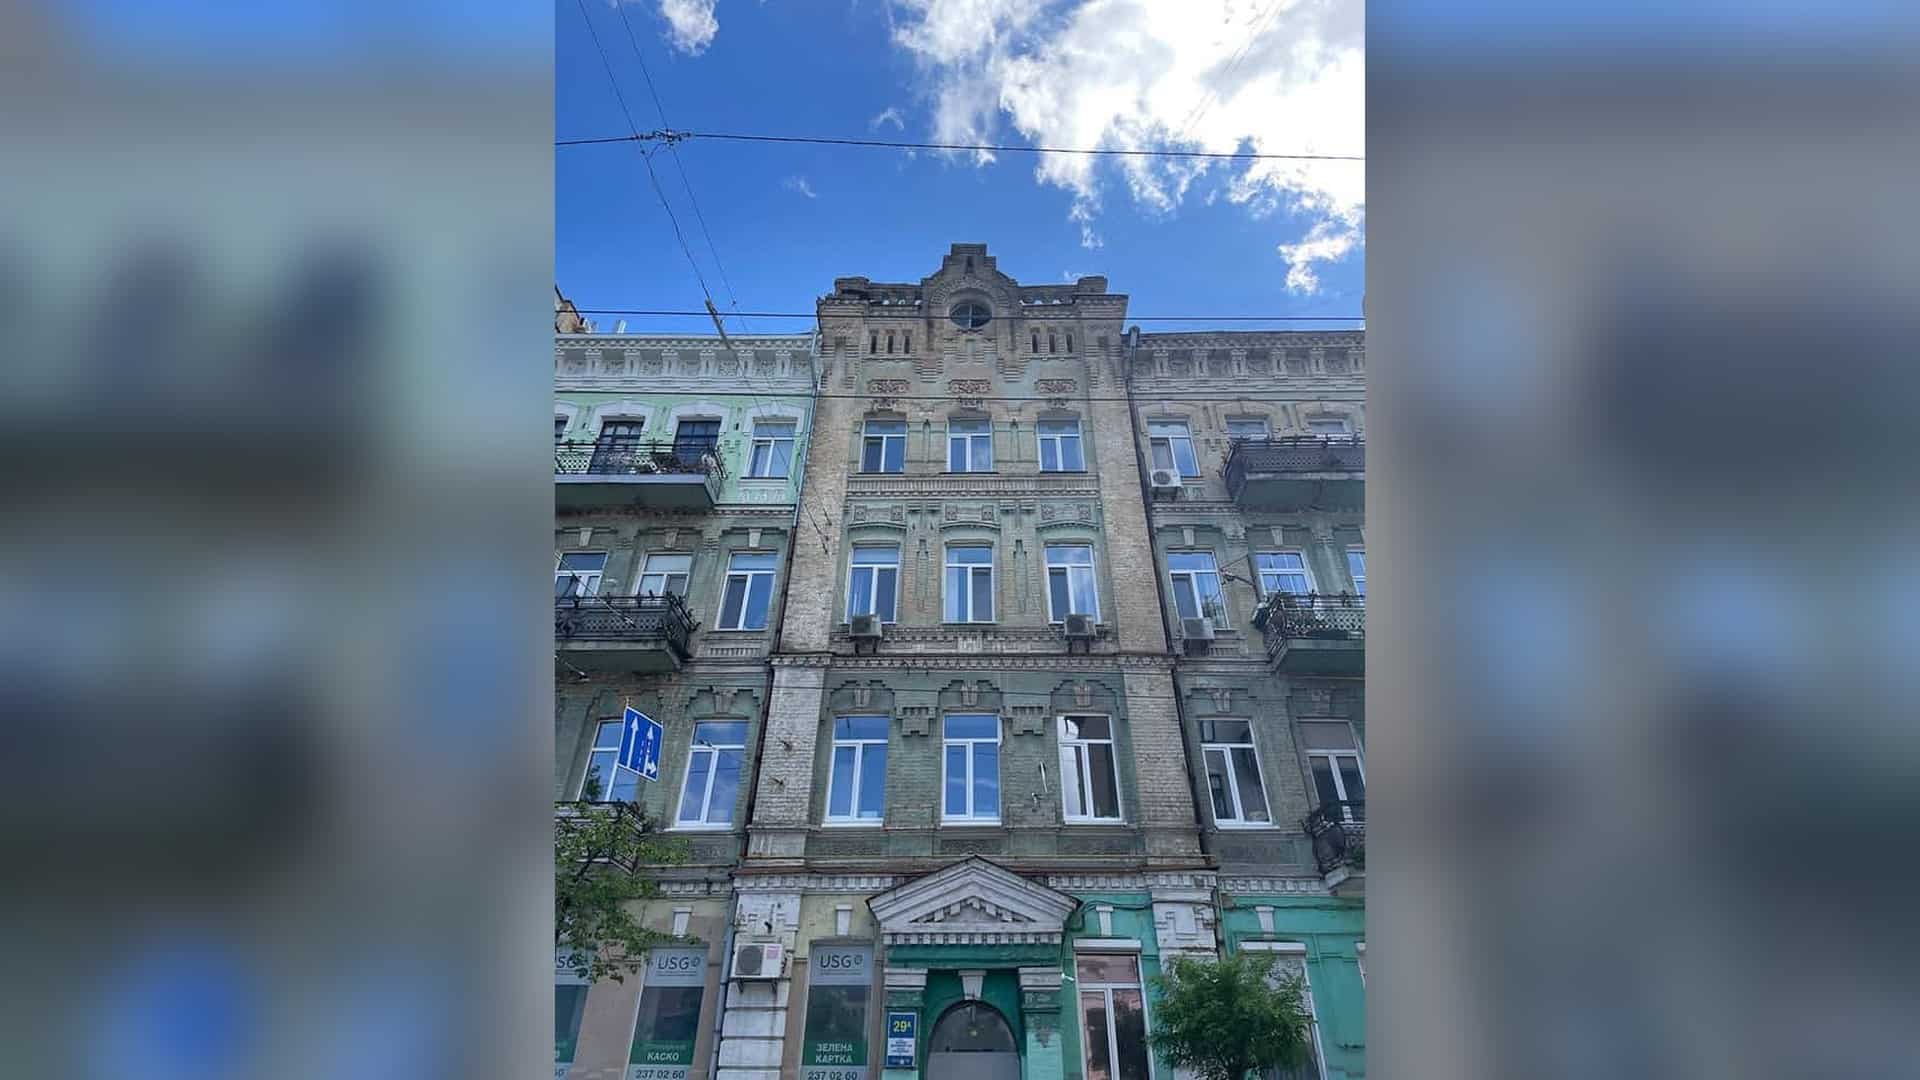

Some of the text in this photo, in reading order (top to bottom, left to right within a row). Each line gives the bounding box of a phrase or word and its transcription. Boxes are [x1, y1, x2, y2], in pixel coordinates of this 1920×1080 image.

[556, 955, 577, 969] SG
[658, 956, 689, 970] USG
[820, 954, 852, 968] USG
[816, 1043, 853, 1052] ЗЕЛЕНА
[647, 1052, 680, 1062] КАСКО
[815, 1054, 853, 1064] КАРТКА
[635, 1070, 685, 1079] 237 02 60
[807, 1070, 826, 1080] 237
[830, 1070, 842, 1080] 02
